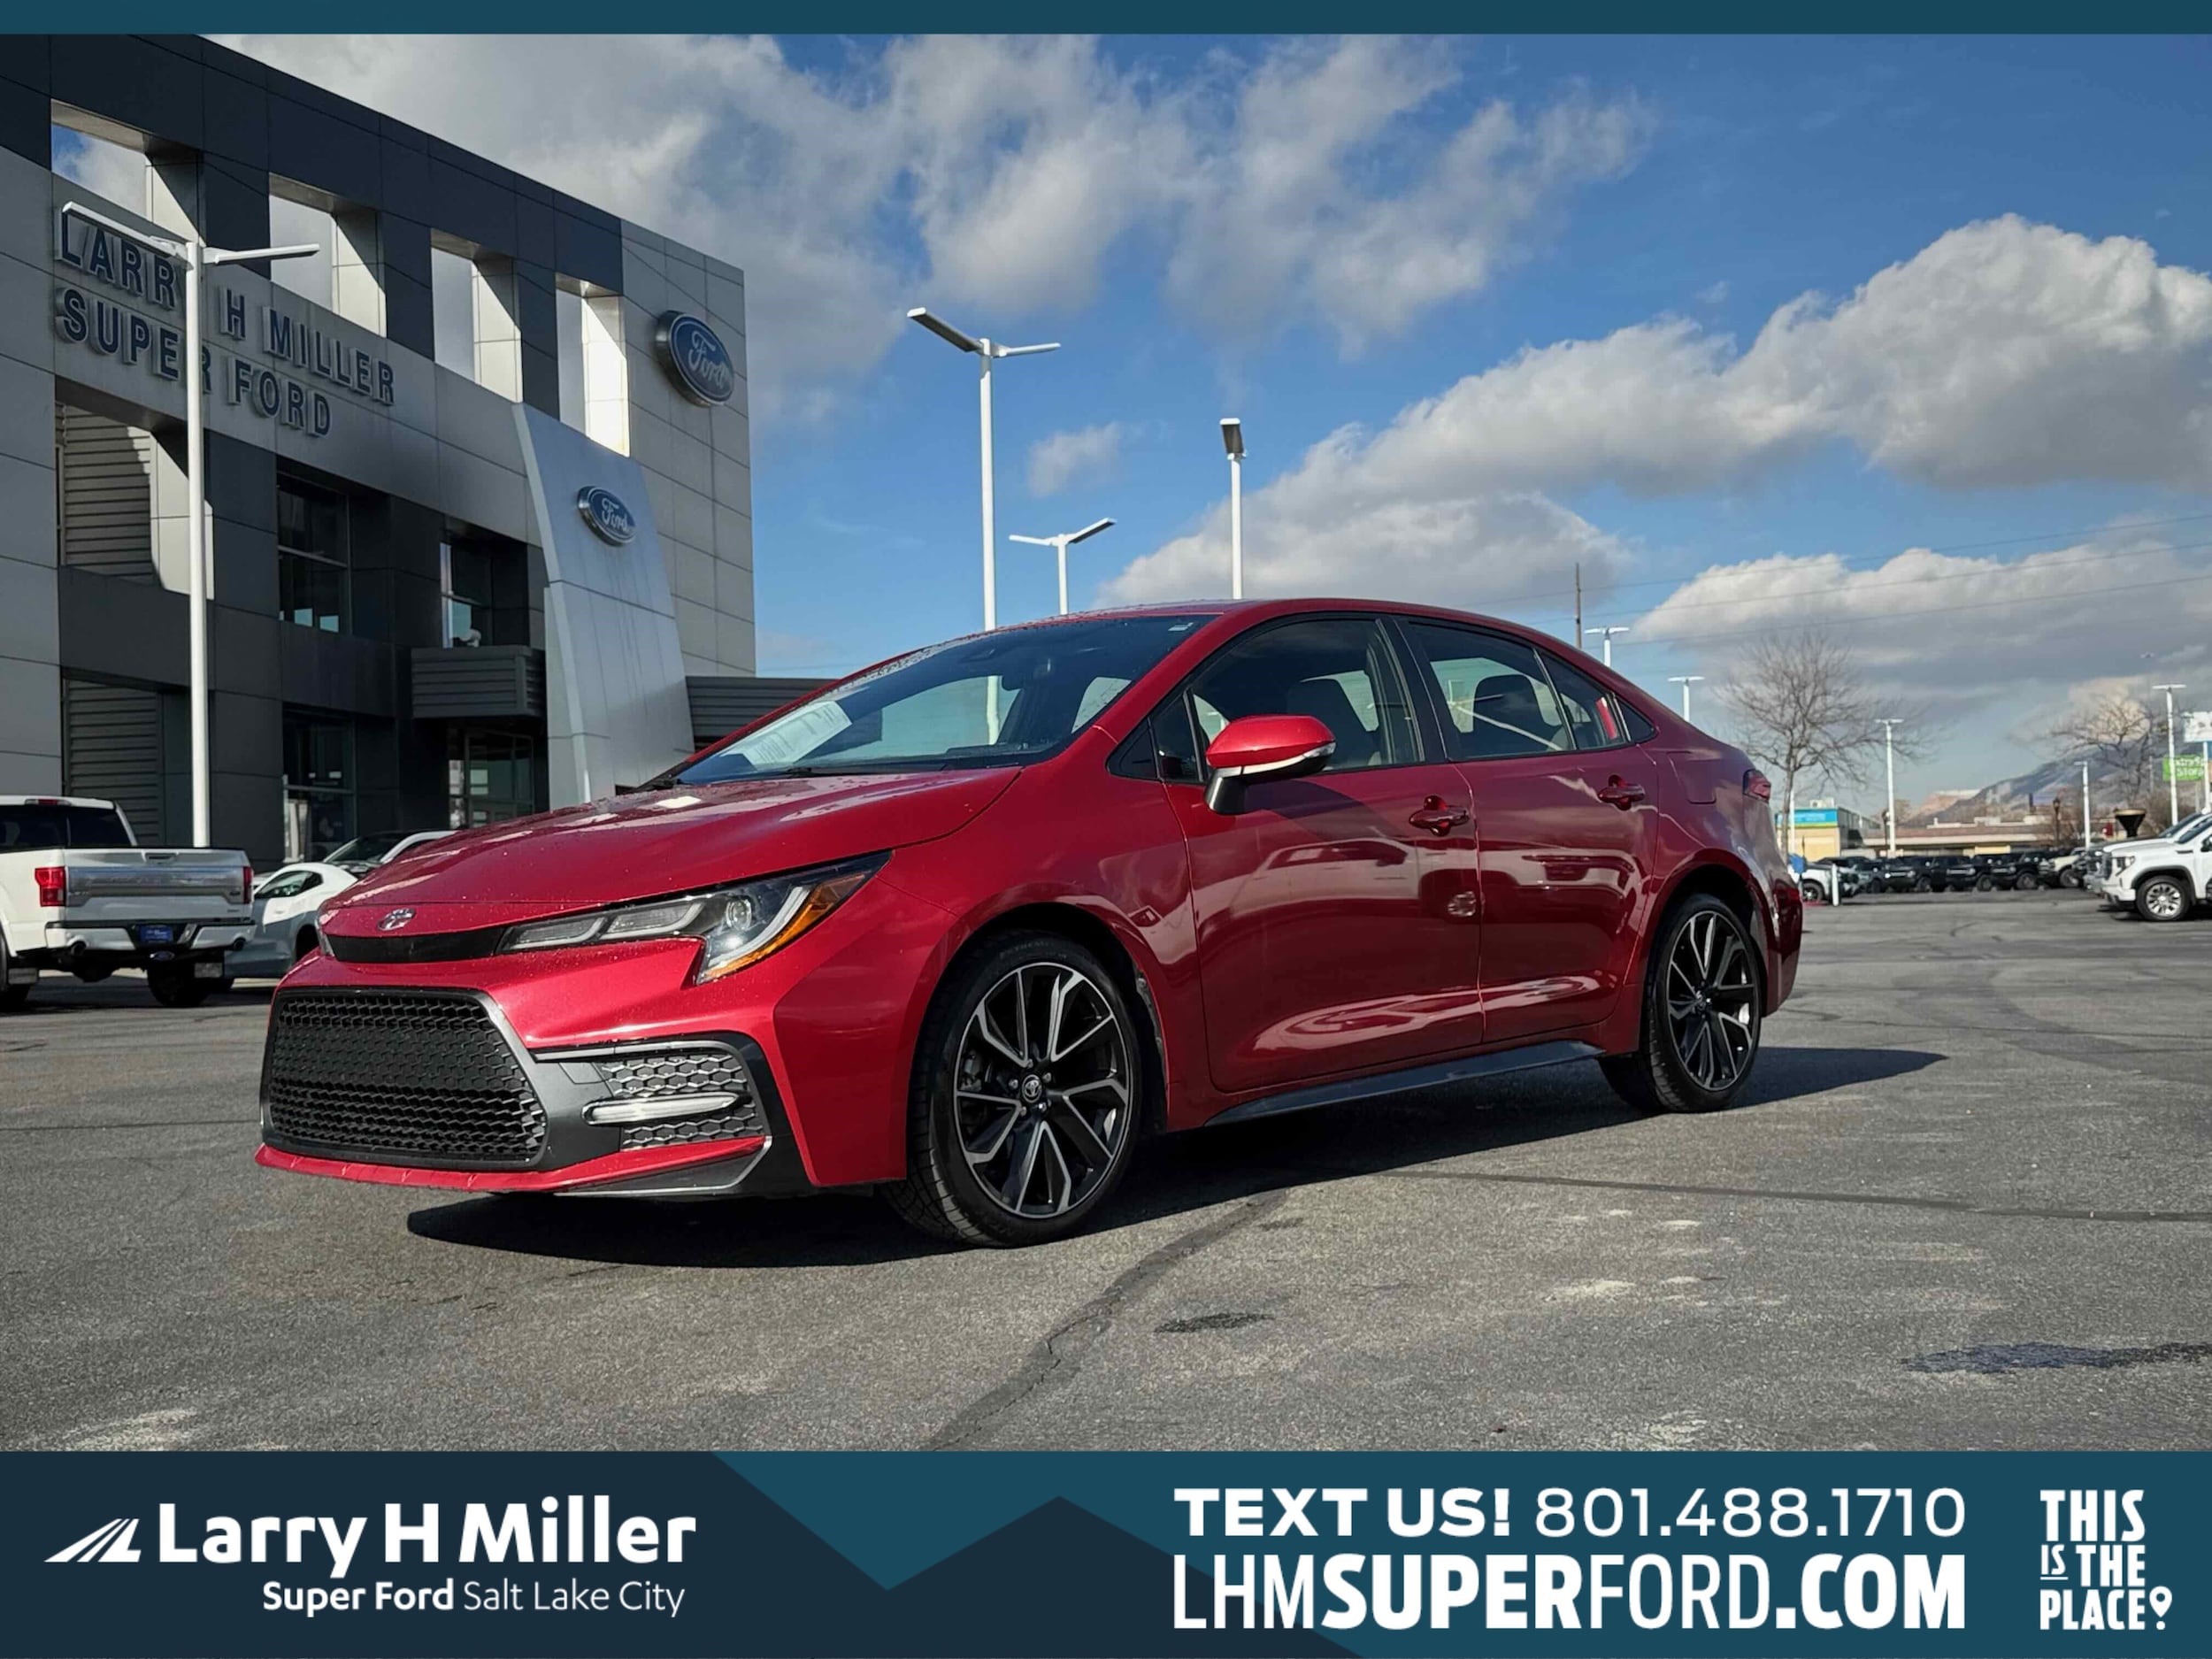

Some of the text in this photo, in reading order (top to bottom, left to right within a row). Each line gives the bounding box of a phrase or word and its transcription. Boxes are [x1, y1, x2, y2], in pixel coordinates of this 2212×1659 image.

[58, 209, 396, 406] LARR H MILLER
[687, 330, 733, 389] Ford
[229, 357, 332, 437] FORD
[601, 497, 634, 532] Ford
